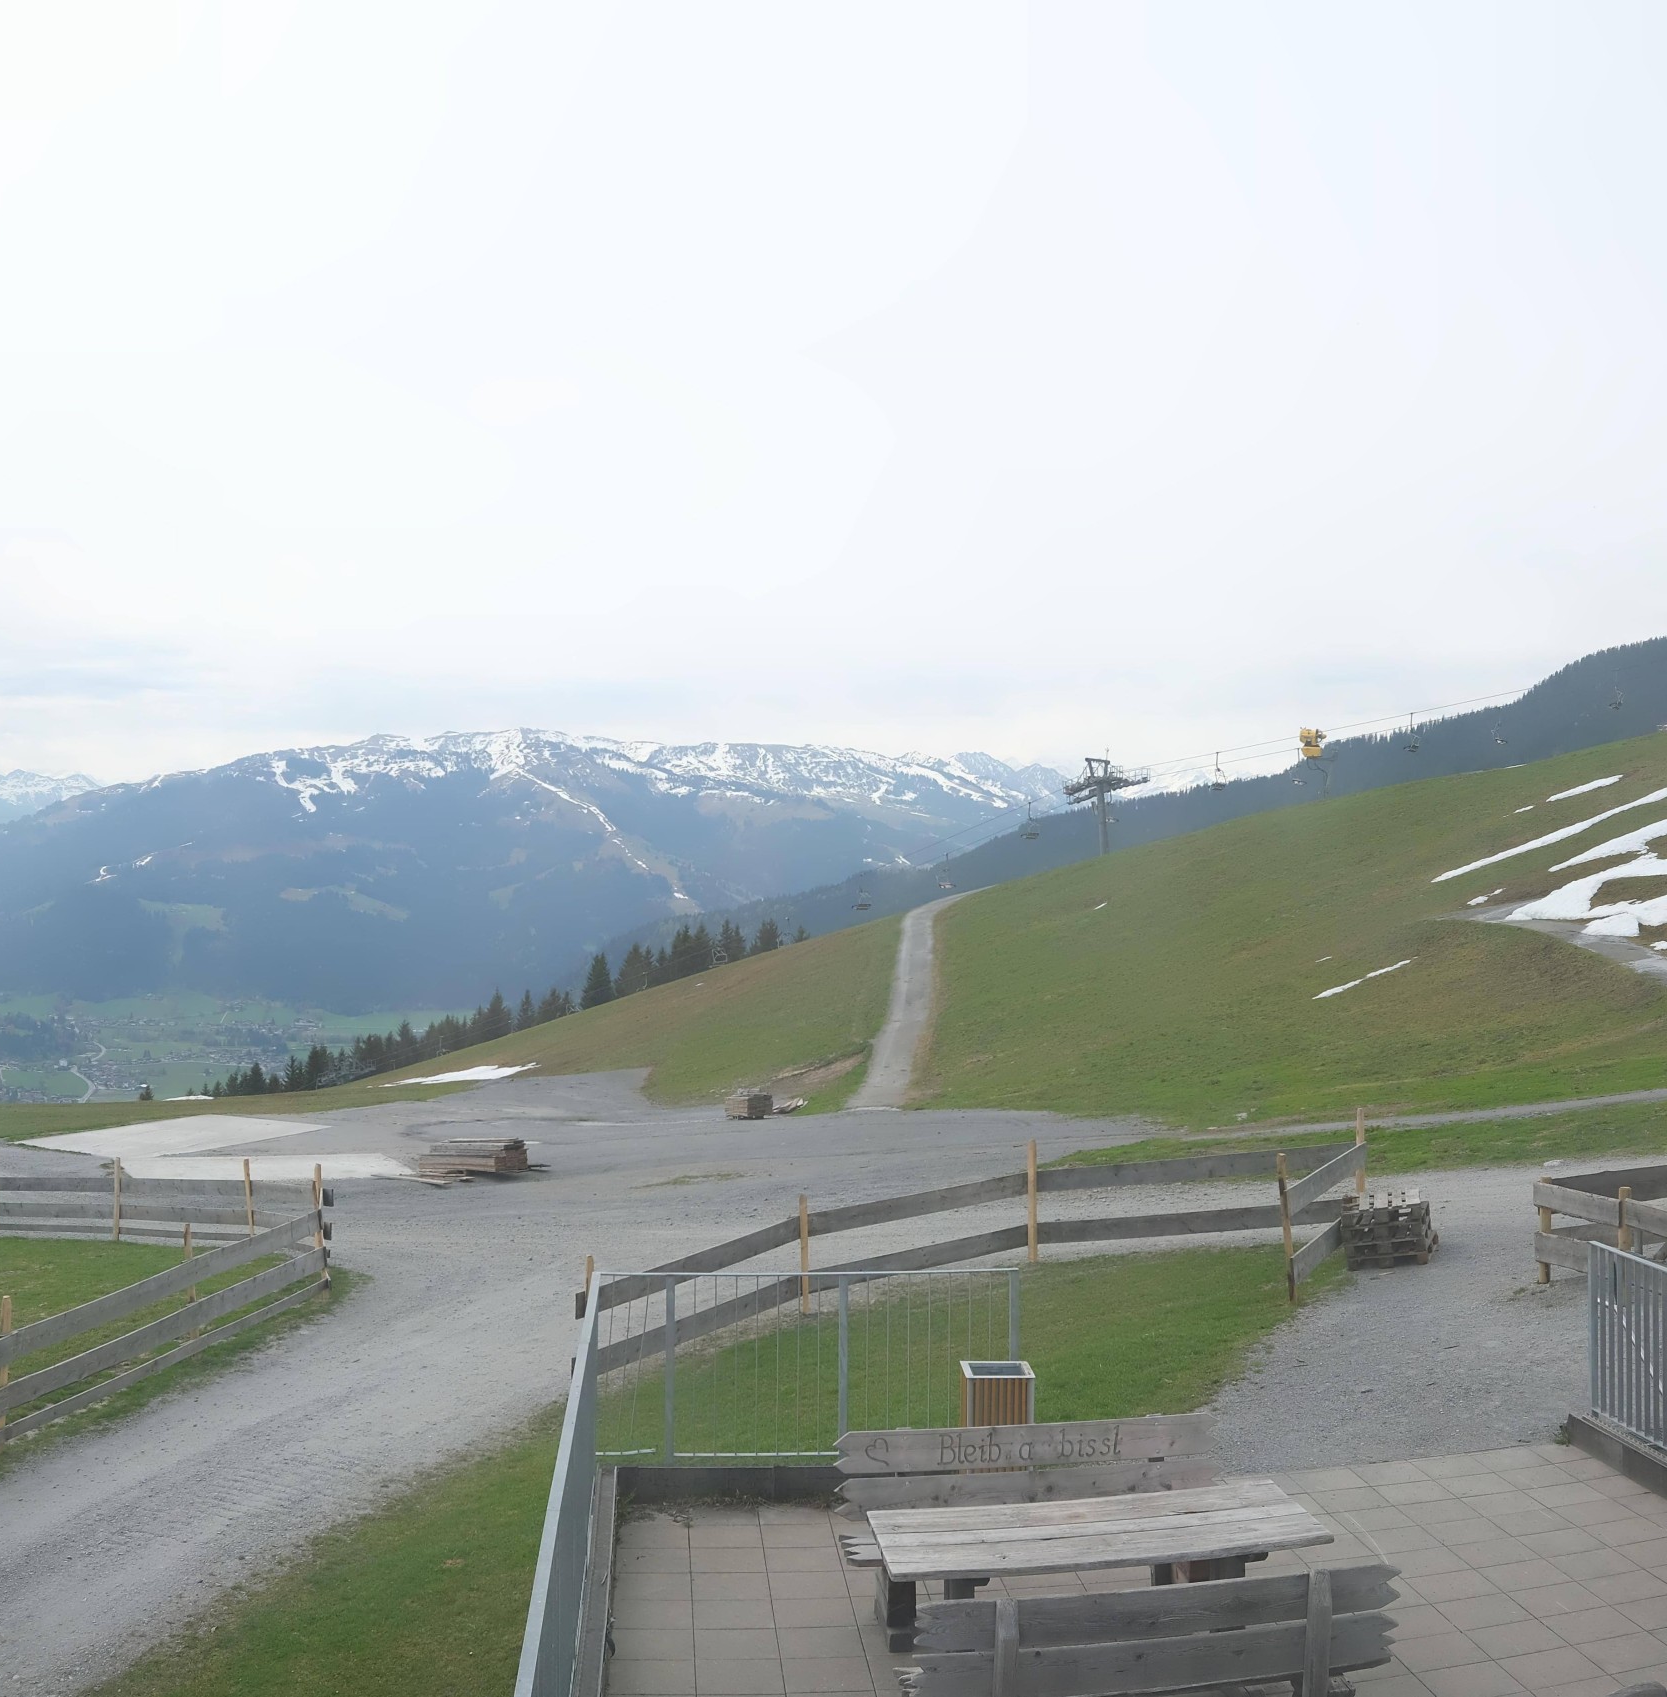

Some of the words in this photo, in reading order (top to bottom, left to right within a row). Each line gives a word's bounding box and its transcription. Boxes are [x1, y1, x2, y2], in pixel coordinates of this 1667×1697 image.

[937, 1431, 1002, 1466] Bleib
[1018, 1440, 1034, 1462] a
[1057, 1425, 1122, 1460] bissl
